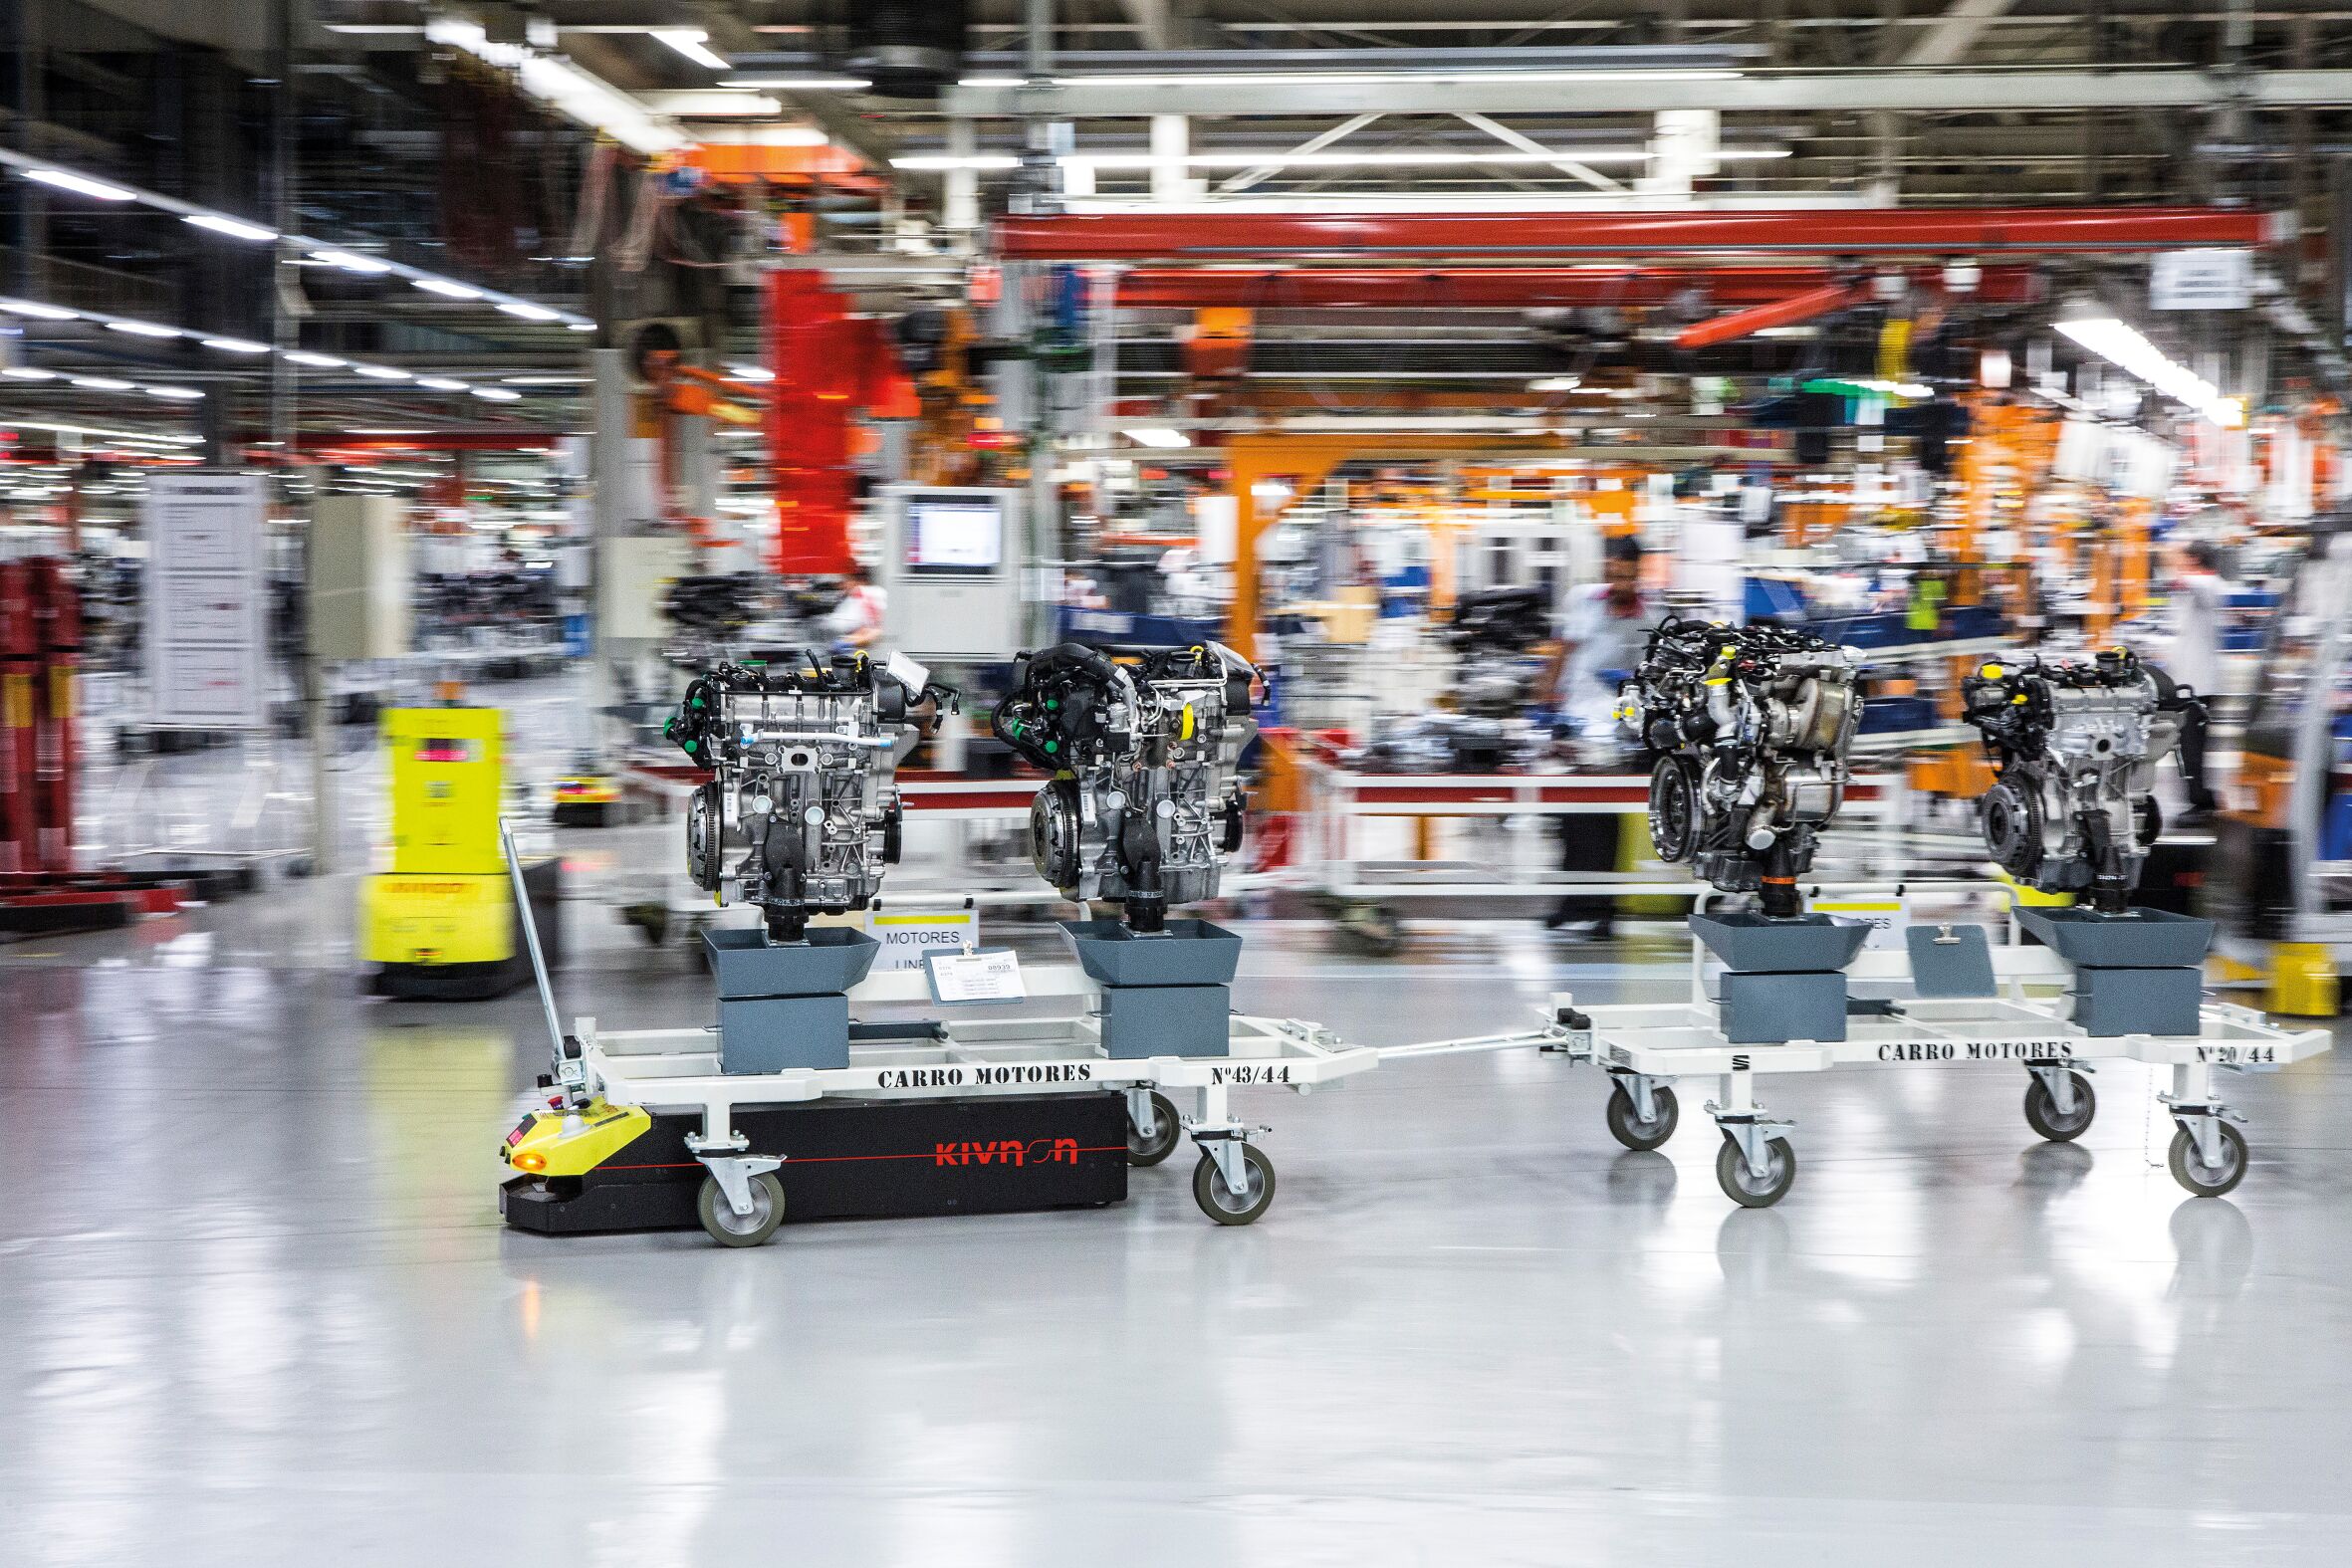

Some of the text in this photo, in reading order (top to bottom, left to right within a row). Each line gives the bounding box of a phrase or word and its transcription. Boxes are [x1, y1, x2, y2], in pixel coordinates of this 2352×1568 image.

[886, 931, 960, 944] MOTORES
[1878, 1041, 2072, 1060] CARRO MOTORES
[877, 1063, 1090, 1088] CARRO MOTORES
